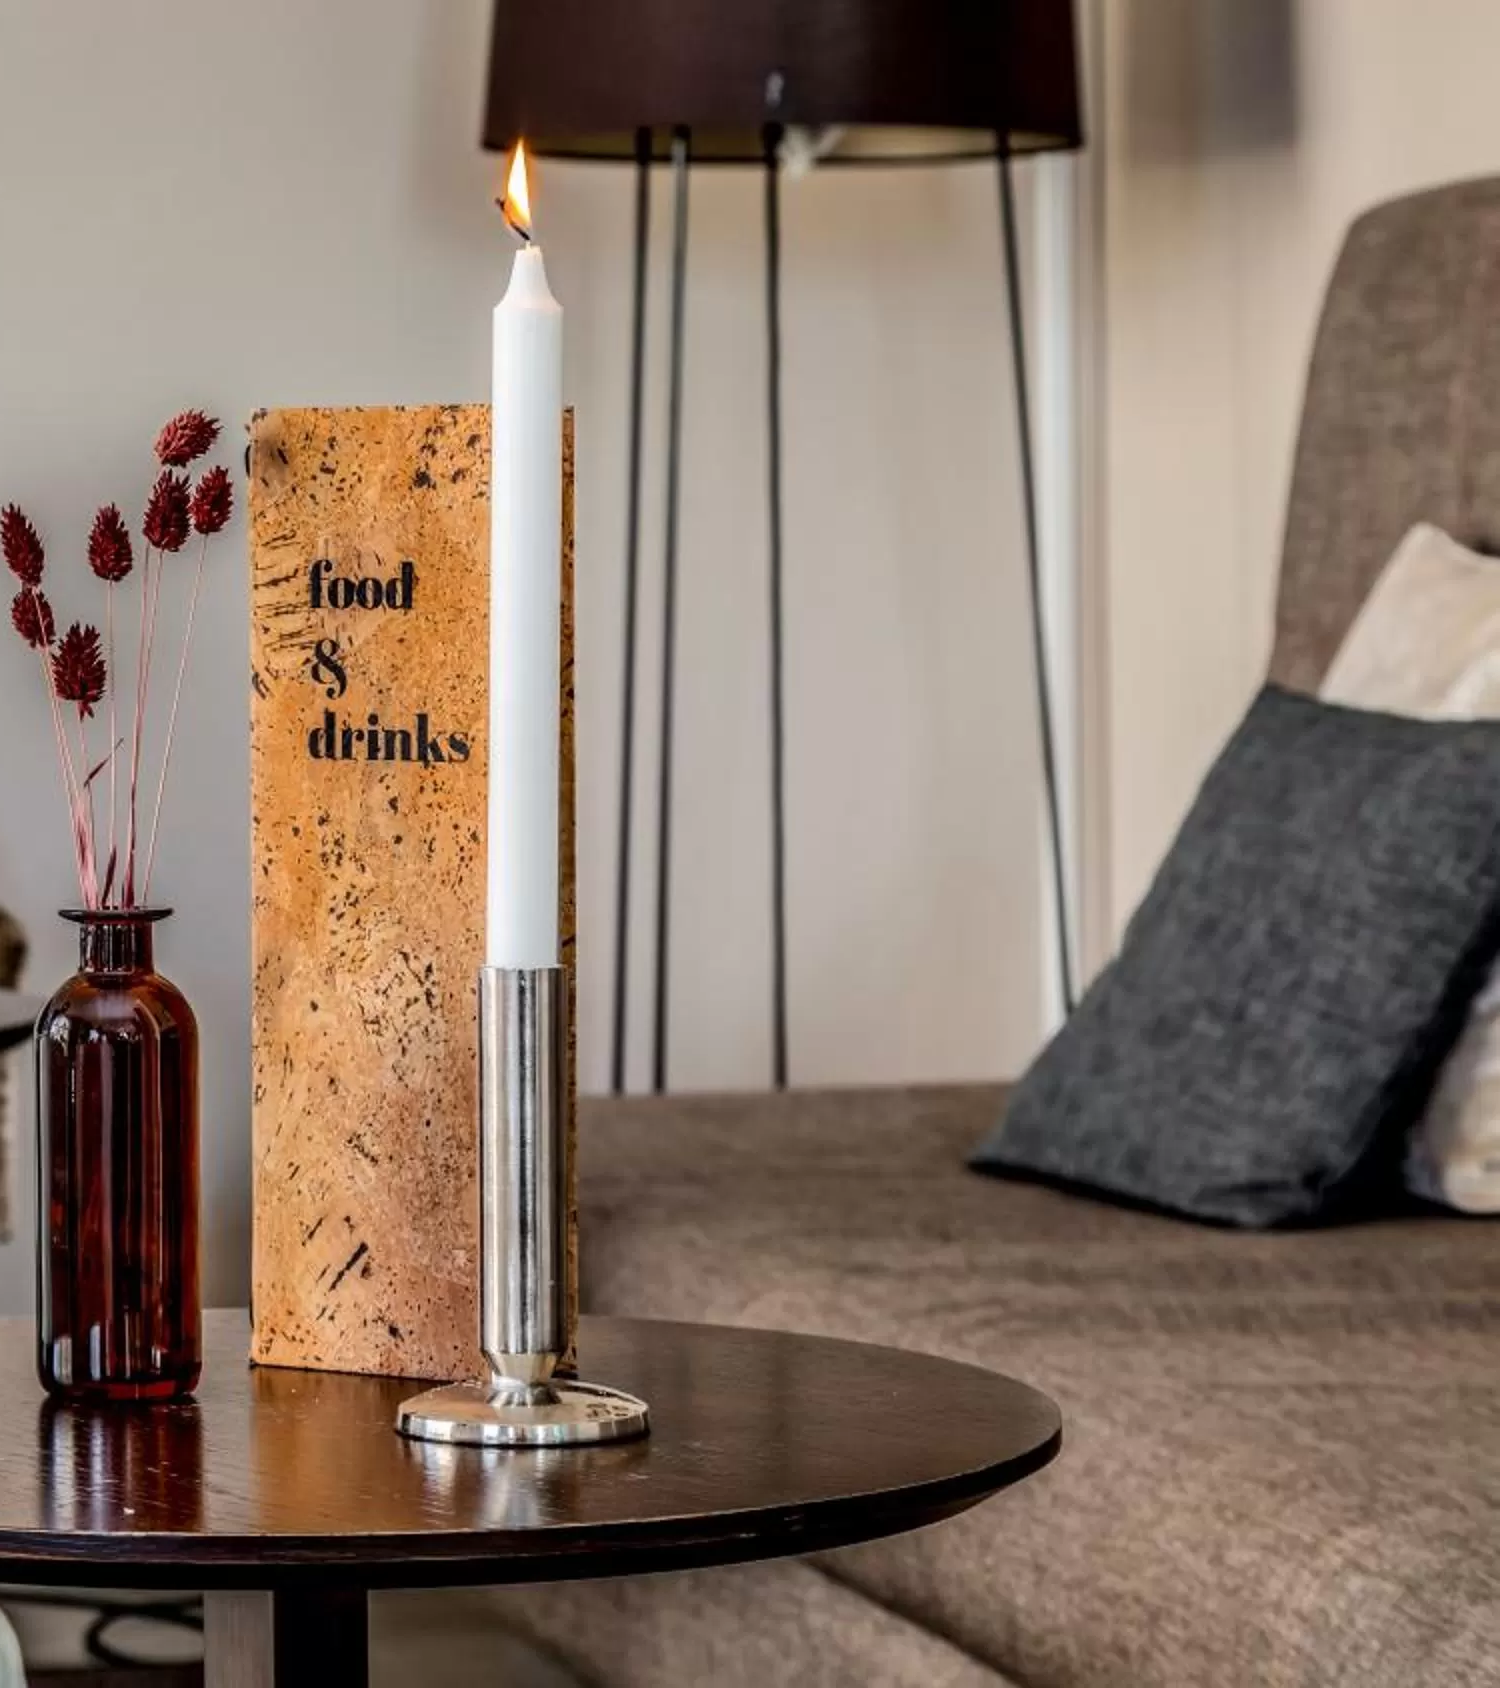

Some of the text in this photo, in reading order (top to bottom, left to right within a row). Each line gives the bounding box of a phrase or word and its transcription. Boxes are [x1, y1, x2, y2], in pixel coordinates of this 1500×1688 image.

[308, 559, 415, 609] food
[309, 637, 348, 699] &
[308, 708, 471, 763] drinks
